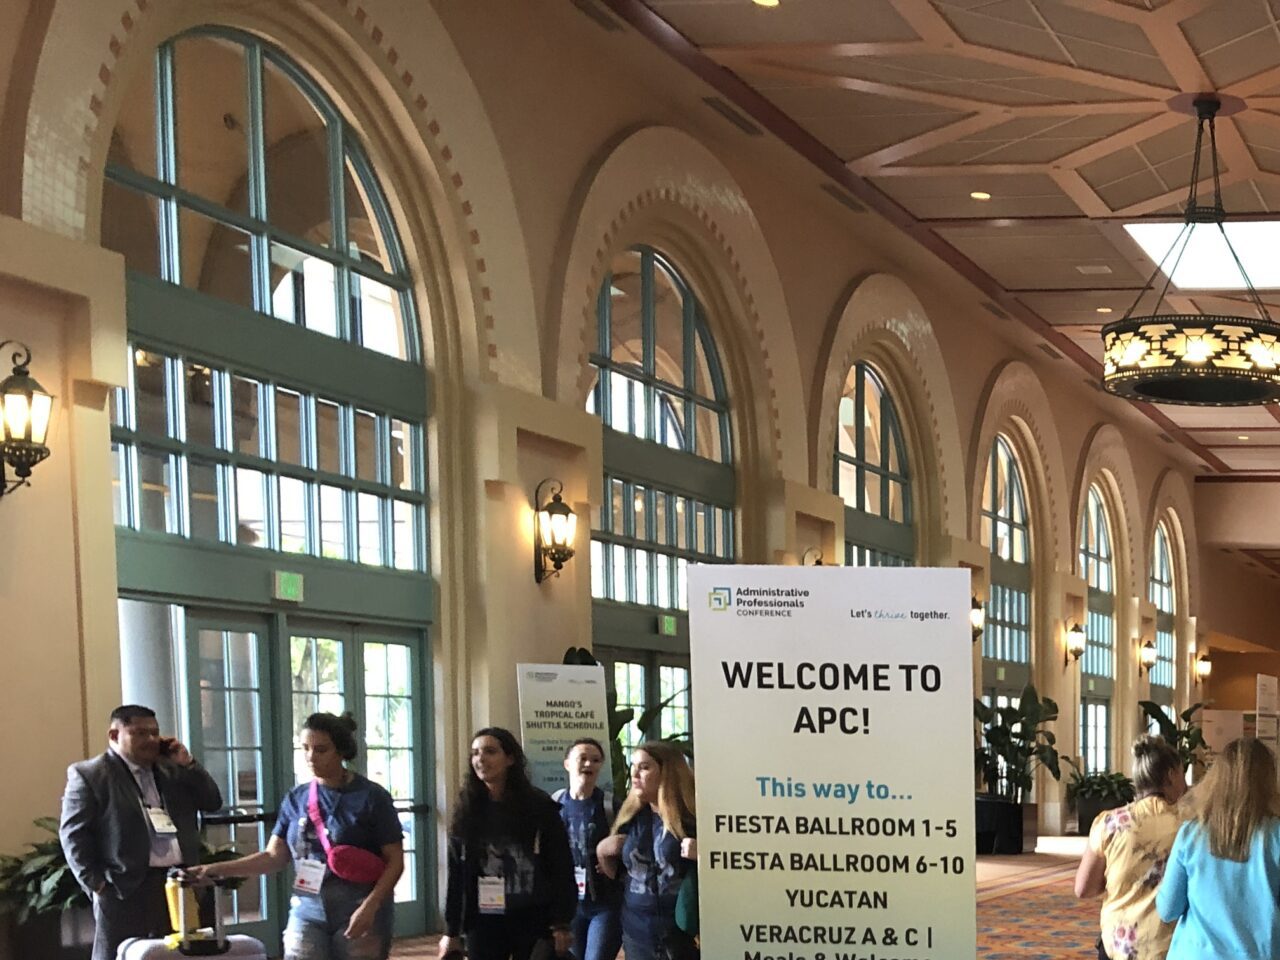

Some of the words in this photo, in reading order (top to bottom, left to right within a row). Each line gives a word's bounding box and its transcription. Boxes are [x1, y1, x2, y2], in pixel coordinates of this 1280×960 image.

[736, 587, 809, 597] Administrative
[736, 598, 805, 608] Professionals
[850, 609, 872, 618] Let's
[910, 610, 950, 620] together.
[722, 661, 890, 691] WELCOME
[899, 665, 941, 692] TO
[575, 711, 594, 719] CAFÉ
[793, 707, 870, 734] APC!
[756, 777, 806, 798] This
[813, 783, 859, 803] way
[866, 780, 912, 800] to...
[715, 815, 790, 835] FIESTA
[796, 817, 915, 837] BALLROOM
[922, 819, 957, 838] 1-5
[710, 851, 784, 871] FIESTA
[790, 853, 909, 873] BALLROOM
[916, 856, 964, 874] 6-10
[786, 889, 888, 908] YUCATAN
[740, 925, 856, 944] VERACRUZ
[861, 928, 877, 945] A
[882, 928, 898, 945] &
[905, 928, 918, 945] C
